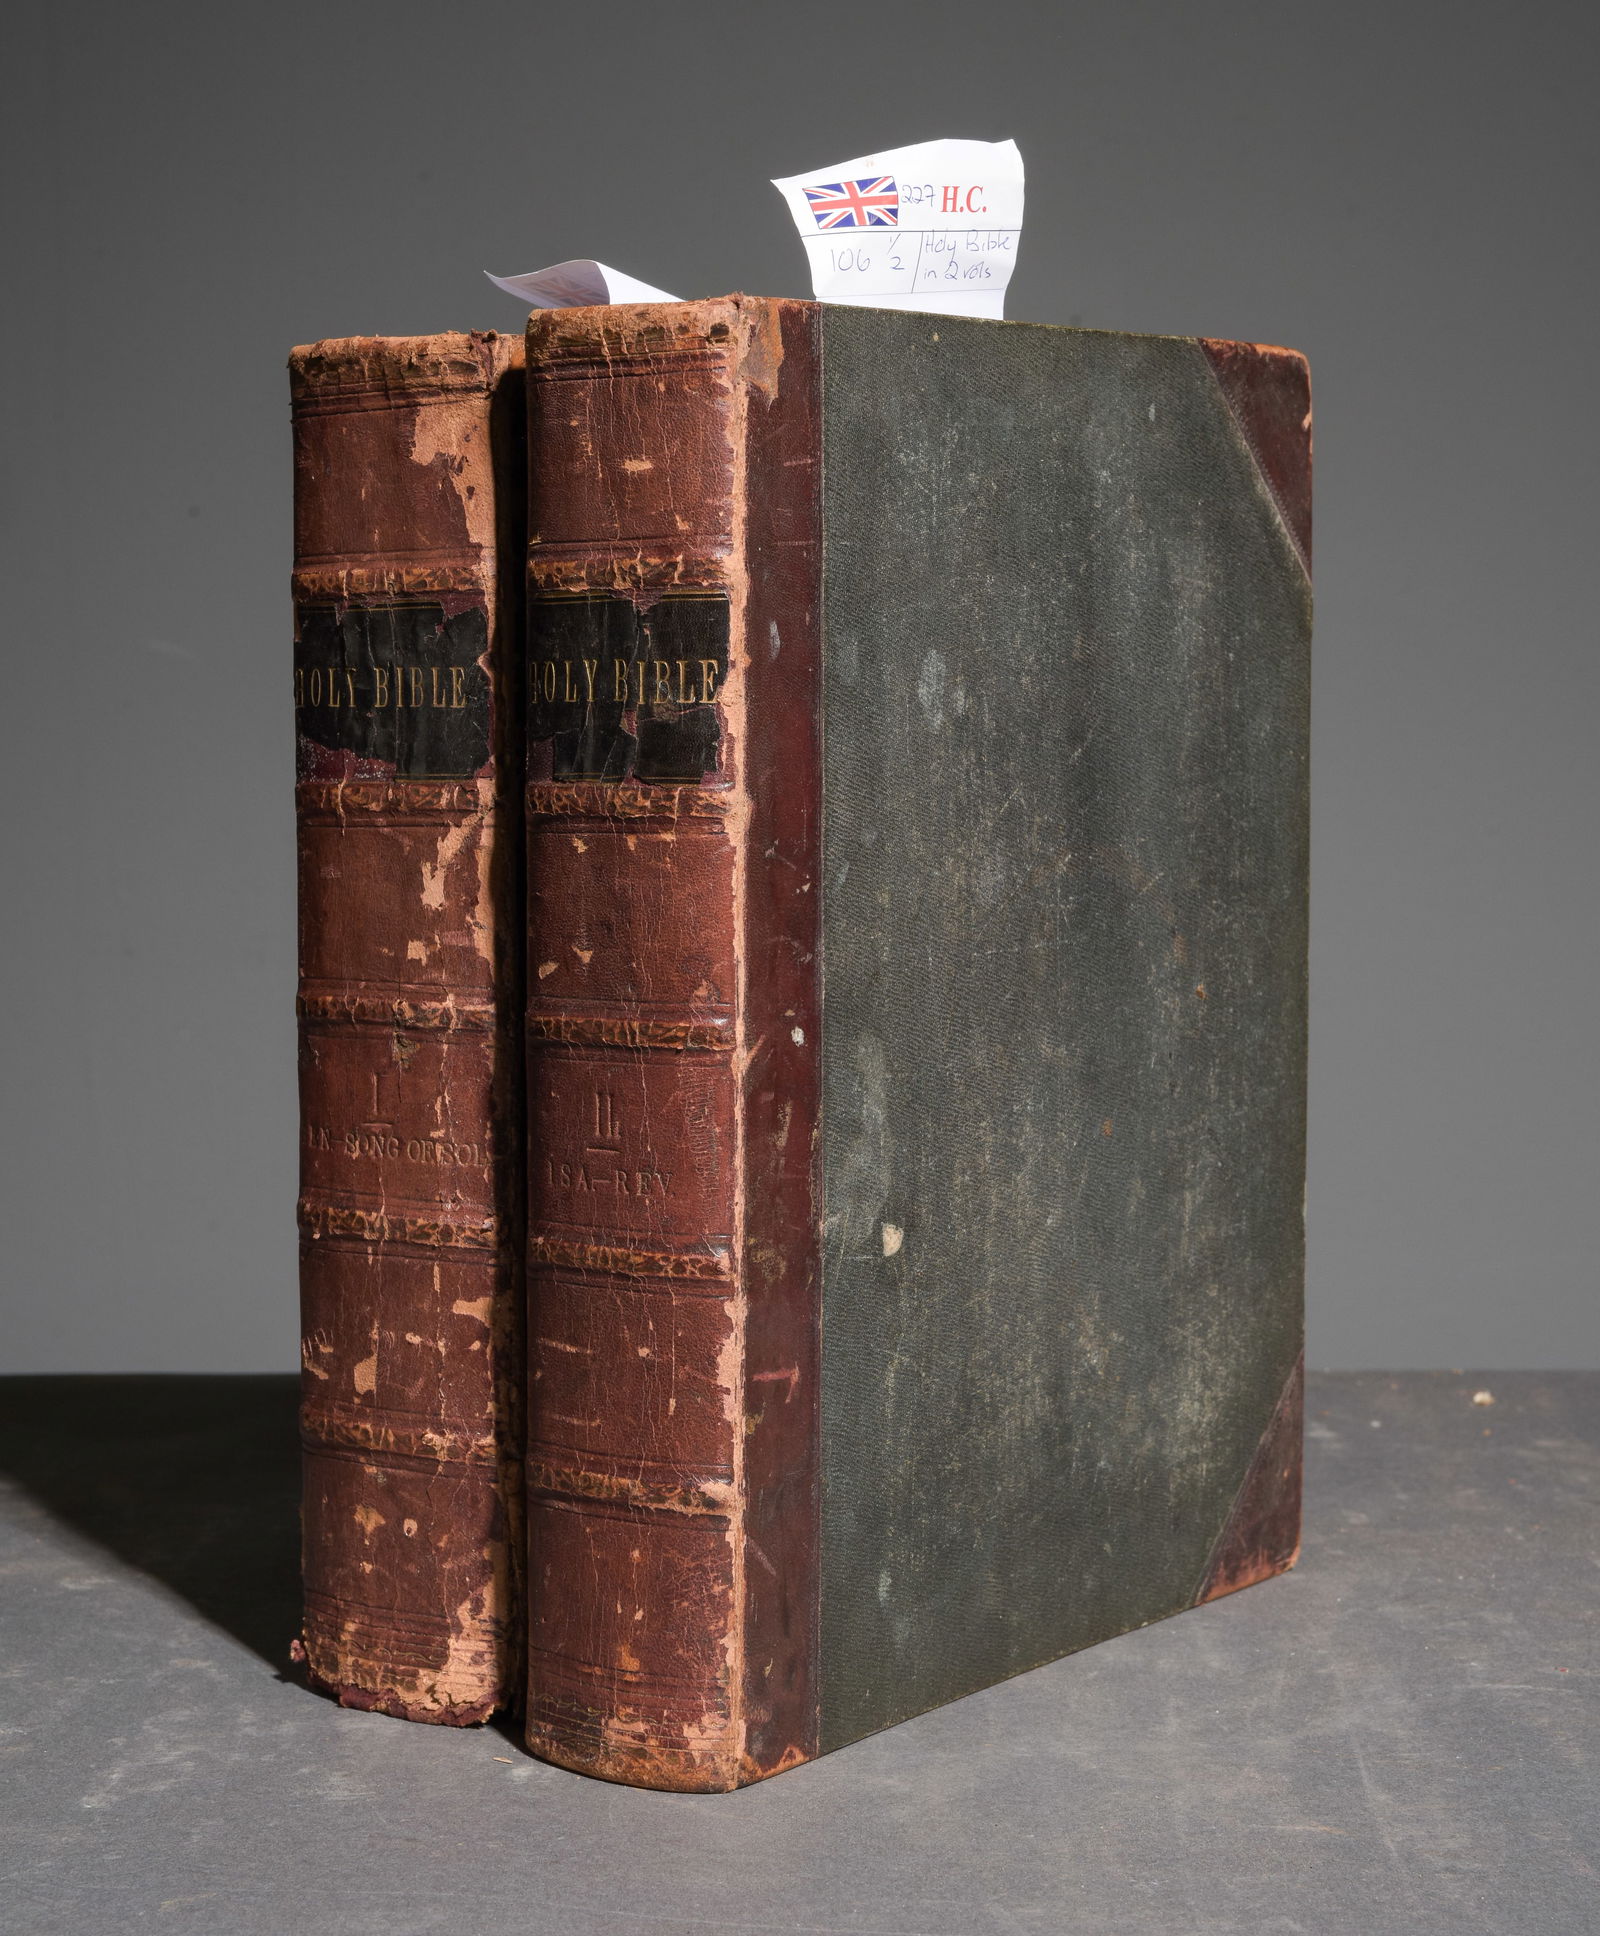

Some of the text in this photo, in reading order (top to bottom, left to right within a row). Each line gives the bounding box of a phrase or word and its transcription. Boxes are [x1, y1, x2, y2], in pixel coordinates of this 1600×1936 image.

[900, 184, 936, 207] 227
[940, 185, 987, 213] H.C.
[966, 229, 1011, 252] Bible
[830, 248, 871, 272] 106
[924, 268, 937, 280] in
[944, 260, 957, 281] 2
[373, 666, 467, 708] BIBLE
[613, 658, 721, 705] BIBLE
